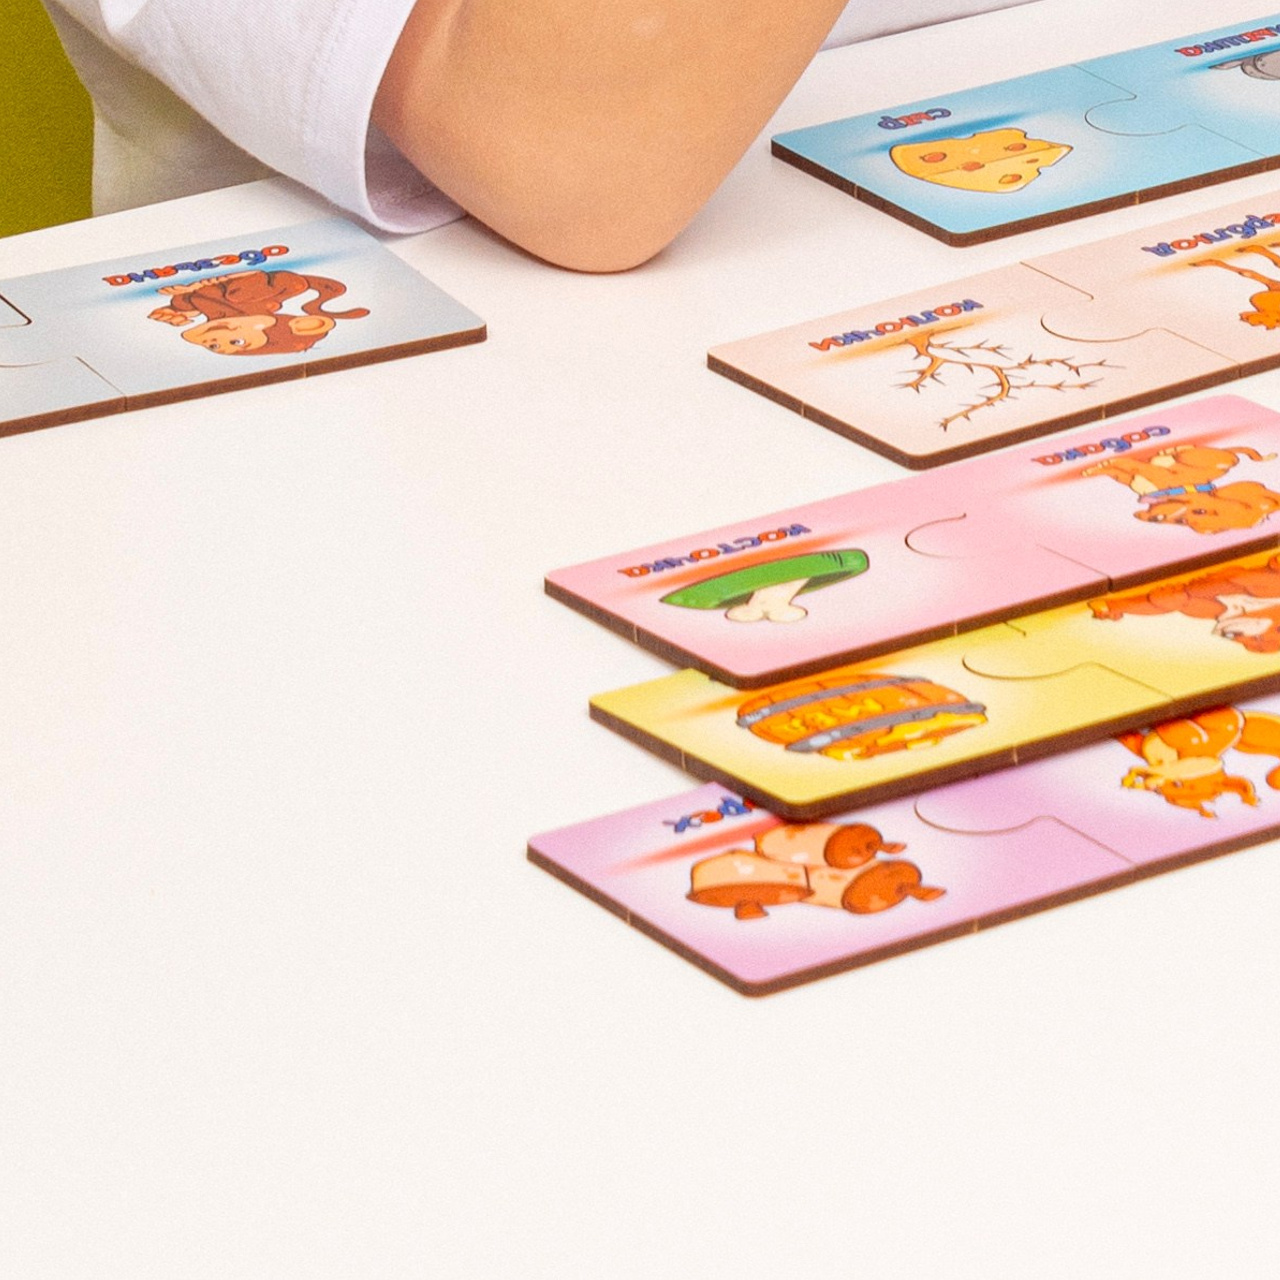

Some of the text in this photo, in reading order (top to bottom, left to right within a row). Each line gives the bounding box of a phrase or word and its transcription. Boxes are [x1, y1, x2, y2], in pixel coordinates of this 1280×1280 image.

[877, 108, 952, 130] сыр
[102, 246, 290, 286] обезьяна
[808, 300, 985, 352] колючки
[1031, 426, 1171, 466] собака
[617, 524, 812, 578] косточка
